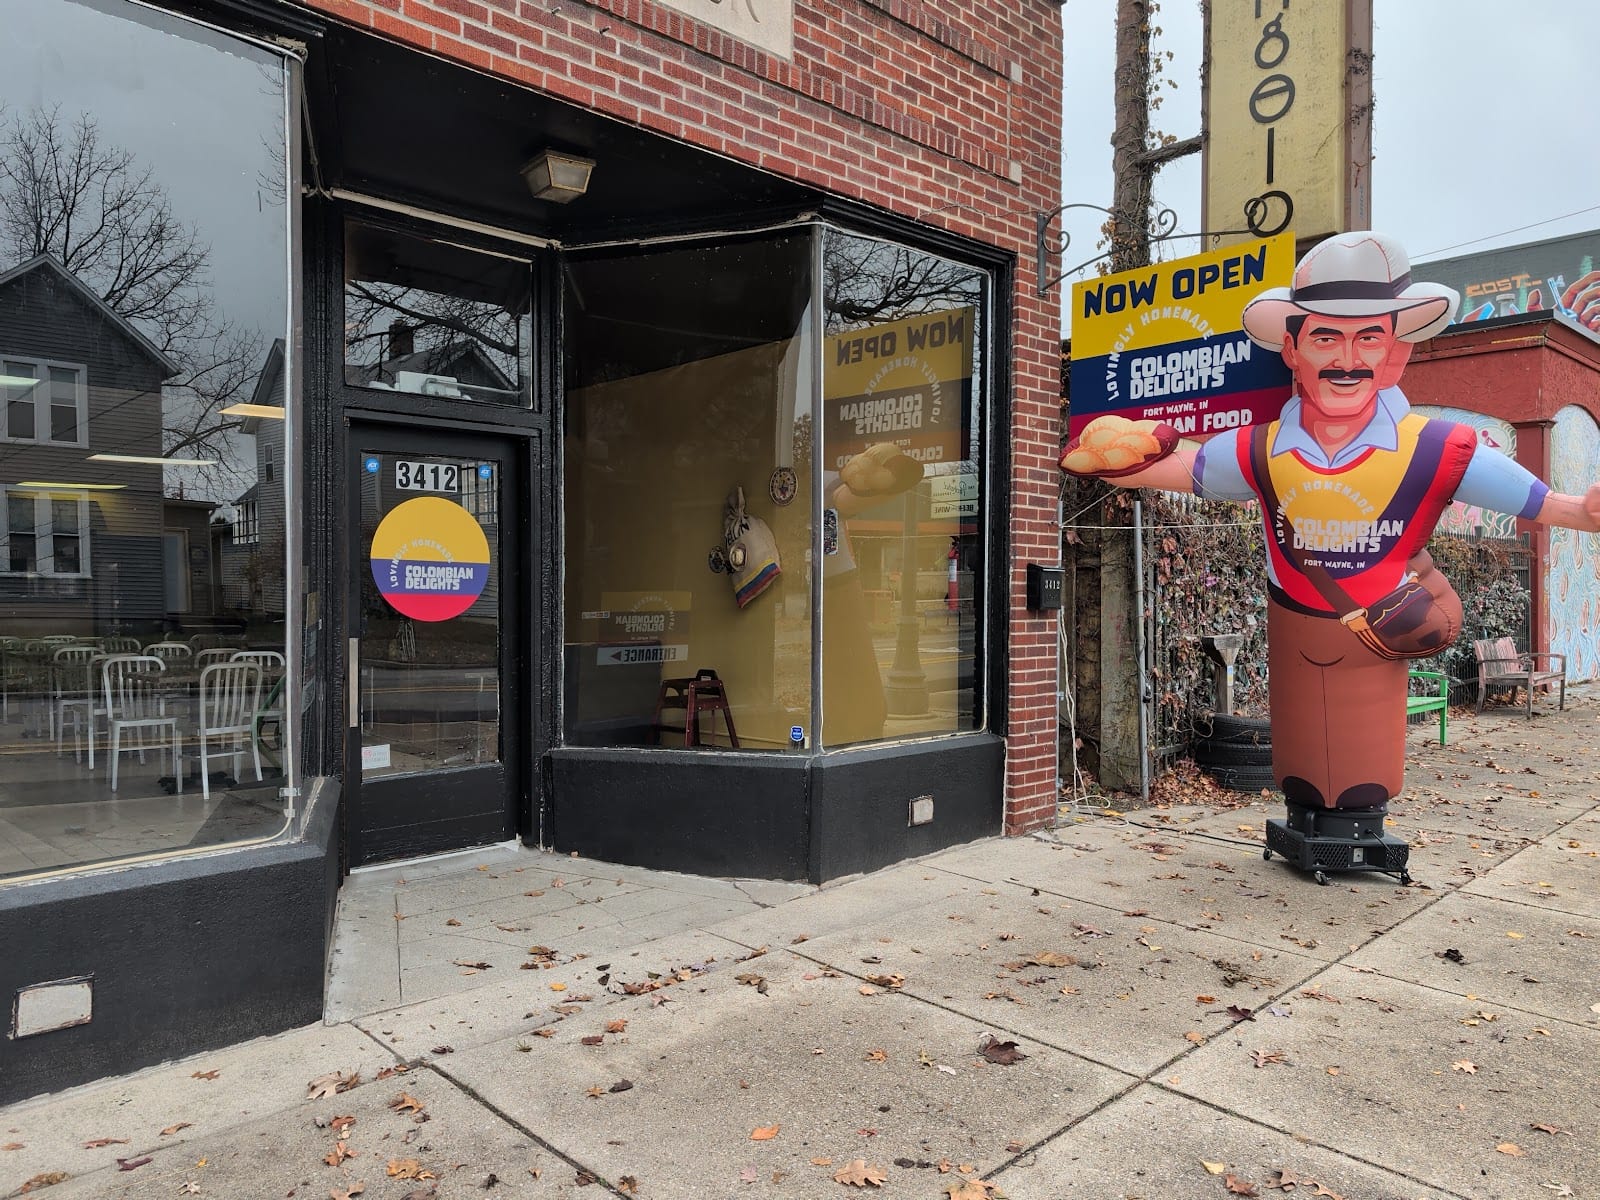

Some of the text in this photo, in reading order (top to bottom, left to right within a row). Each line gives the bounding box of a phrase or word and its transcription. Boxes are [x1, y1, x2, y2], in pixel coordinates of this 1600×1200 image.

[1084, 244, 1267, 319] NOW OPEN
[1106, 306, 1216, 401] LOVINGLY HOMEMADE
[1130, 338, 1251, 380] COLOMBIAN
[1130, 365, 1226, 400] DELIGHTS
[1143, 399, 1209, 418] FORT WAYNE, IN
[1202, 408, 1253, 432] FOOD
[397, 462, 457, 491] 3412
[1293, 517, 1404, 537] COLOMBIAN
[1293, 533, 1383, 553] DELIGHTS
[405, 564, 473, 580] COLOMBIAN
[1304, 559, 1366, 570] FORT WAYNE, IN
[405, 577, 460, 591] DELIGHTS
